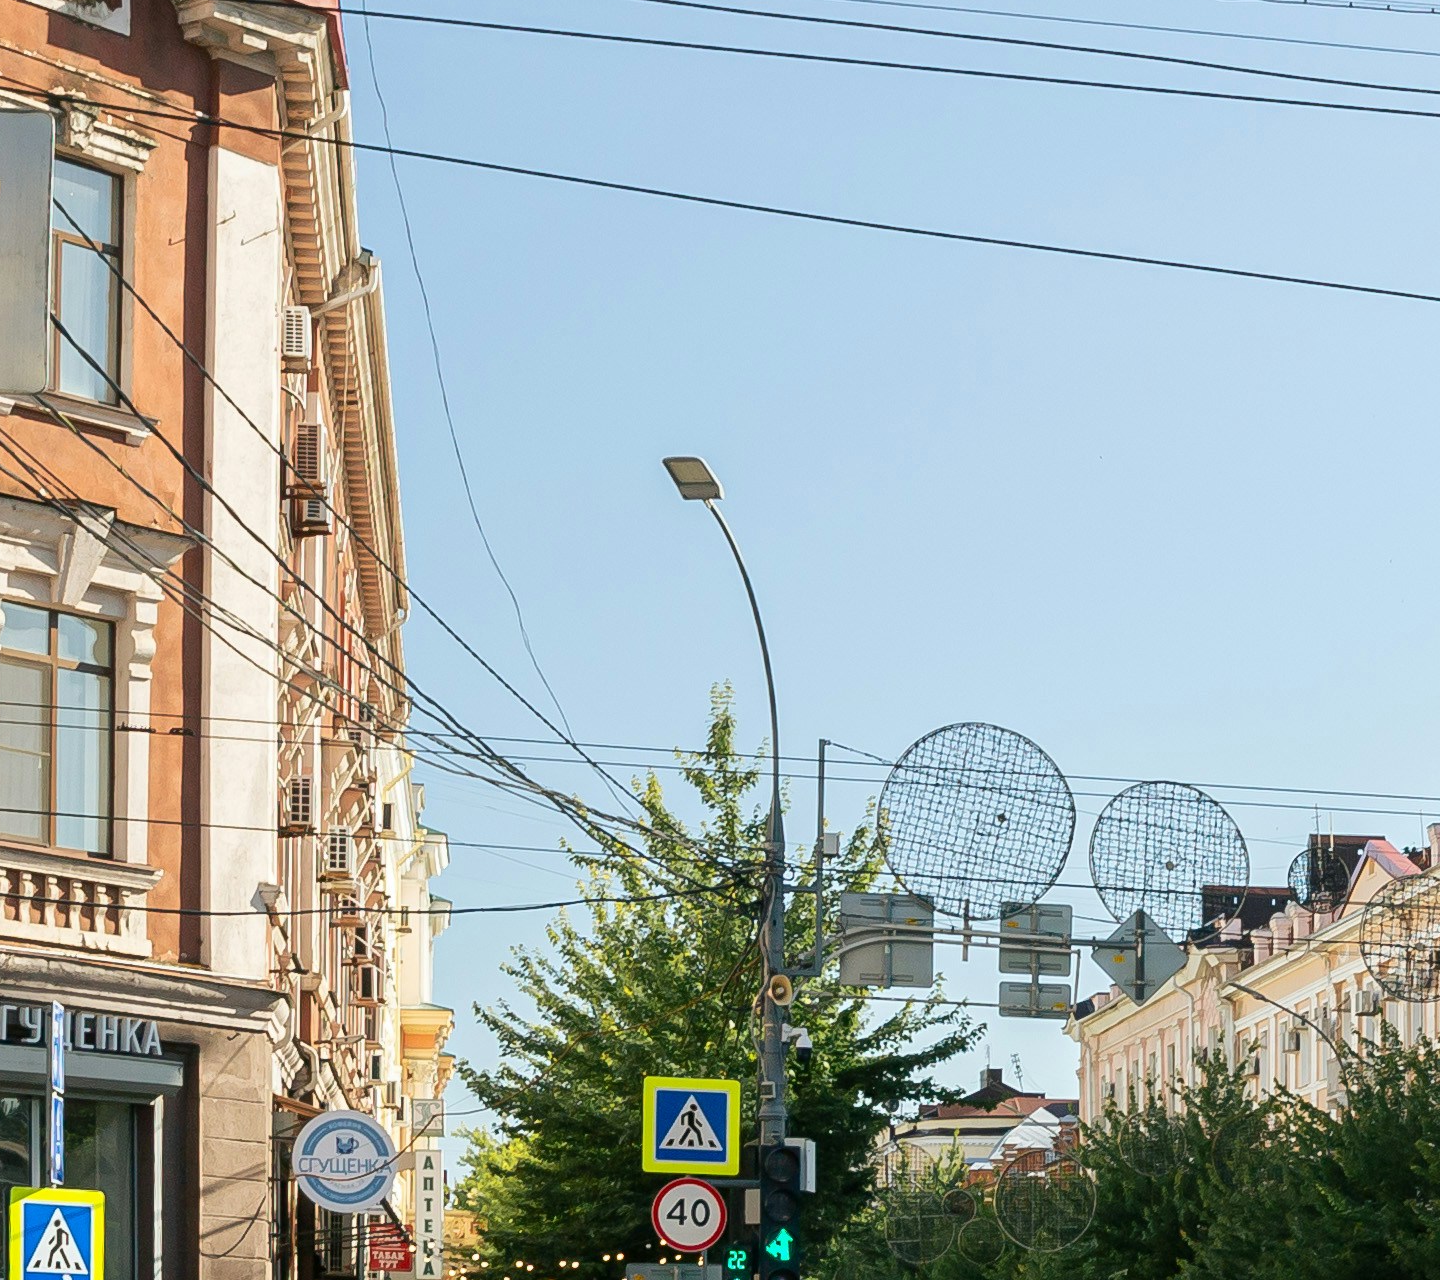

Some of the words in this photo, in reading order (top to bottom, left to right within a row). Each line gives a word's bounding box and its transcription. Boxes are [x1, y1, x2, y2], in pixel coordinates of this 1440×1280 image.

[298, 1156, 392, 1176] СГУЩЕНКА
[666, 1198, 710, 1227] 40
[372, 1250, 405, 1261] ТАБАК
[378, 1260, 399, 1269] ТУТ
[727, 1251, 747, 1270] 22
